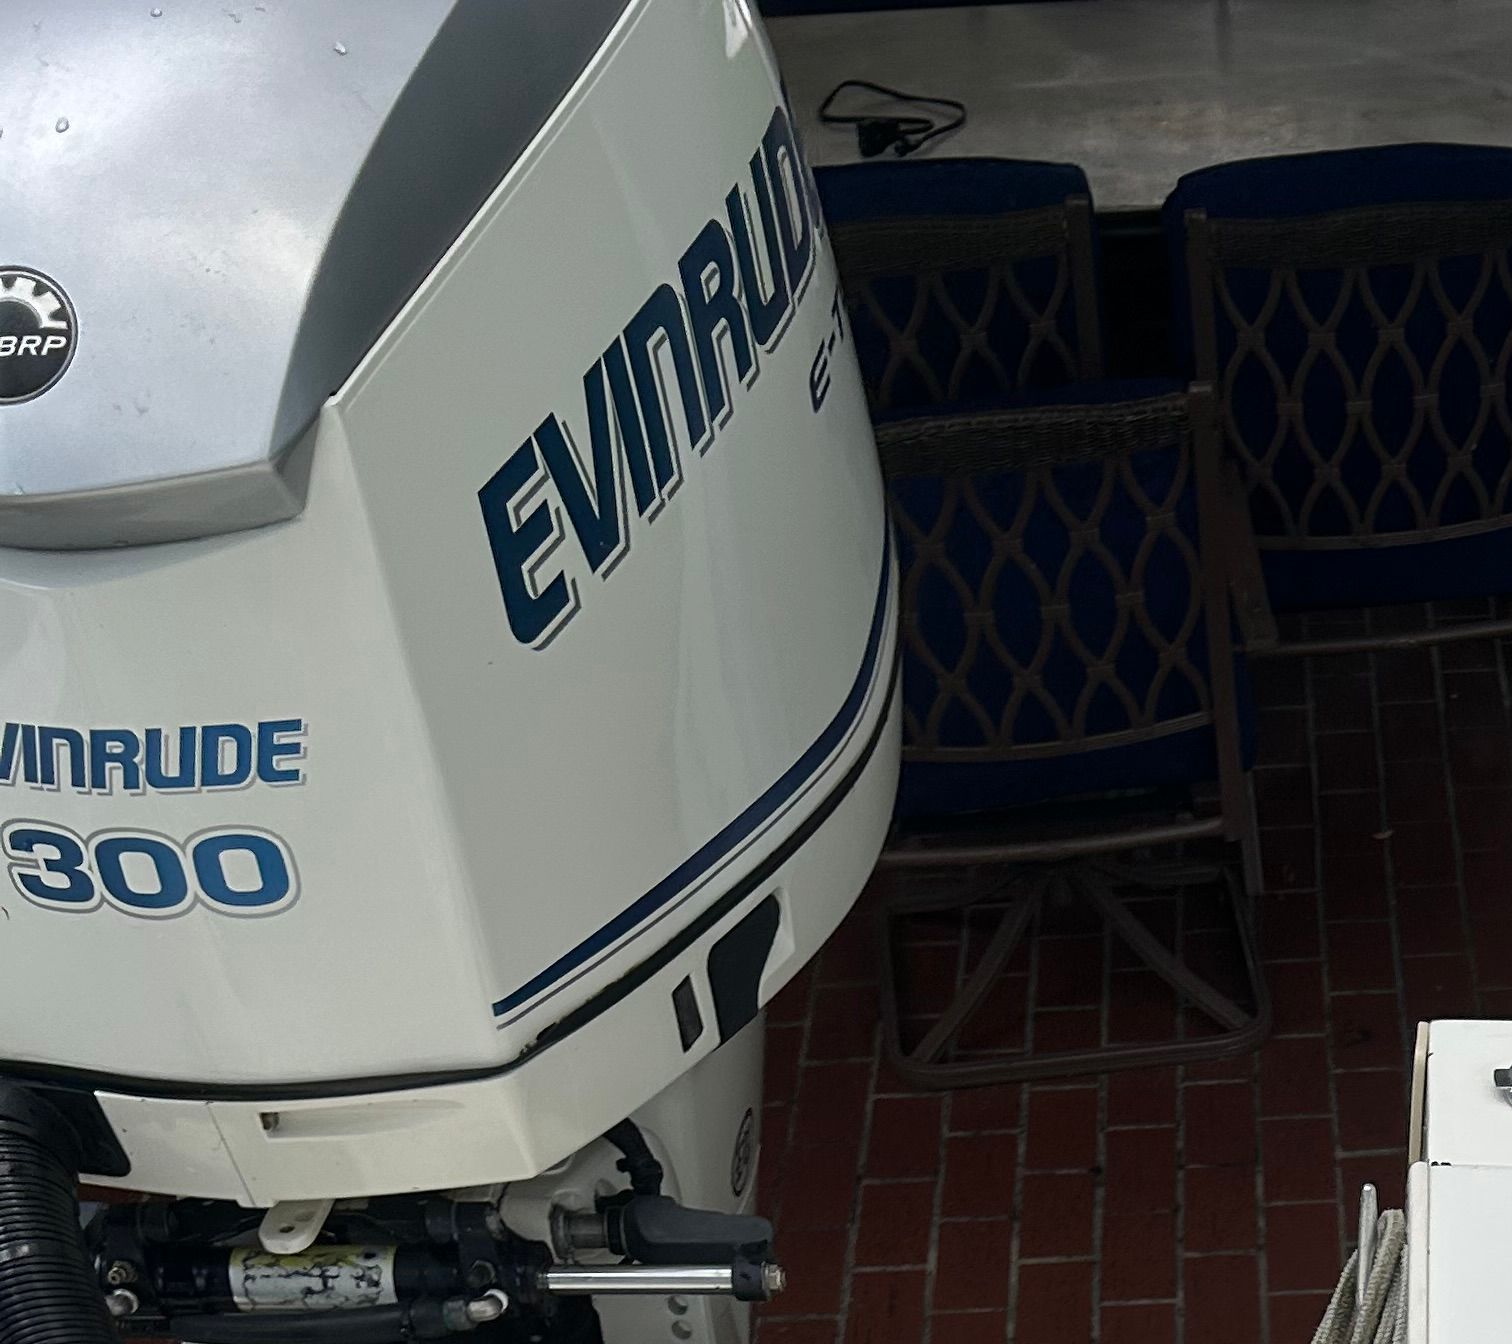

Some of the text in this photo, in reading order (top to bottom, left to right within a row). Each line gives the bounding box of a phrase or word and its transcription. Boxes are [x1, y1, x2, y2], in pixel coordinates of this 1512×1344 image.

[0, 336, 67, 357] BRP
[479, 106, 822, 648] EVINRUD
[3, 820, 298, 917] 300
